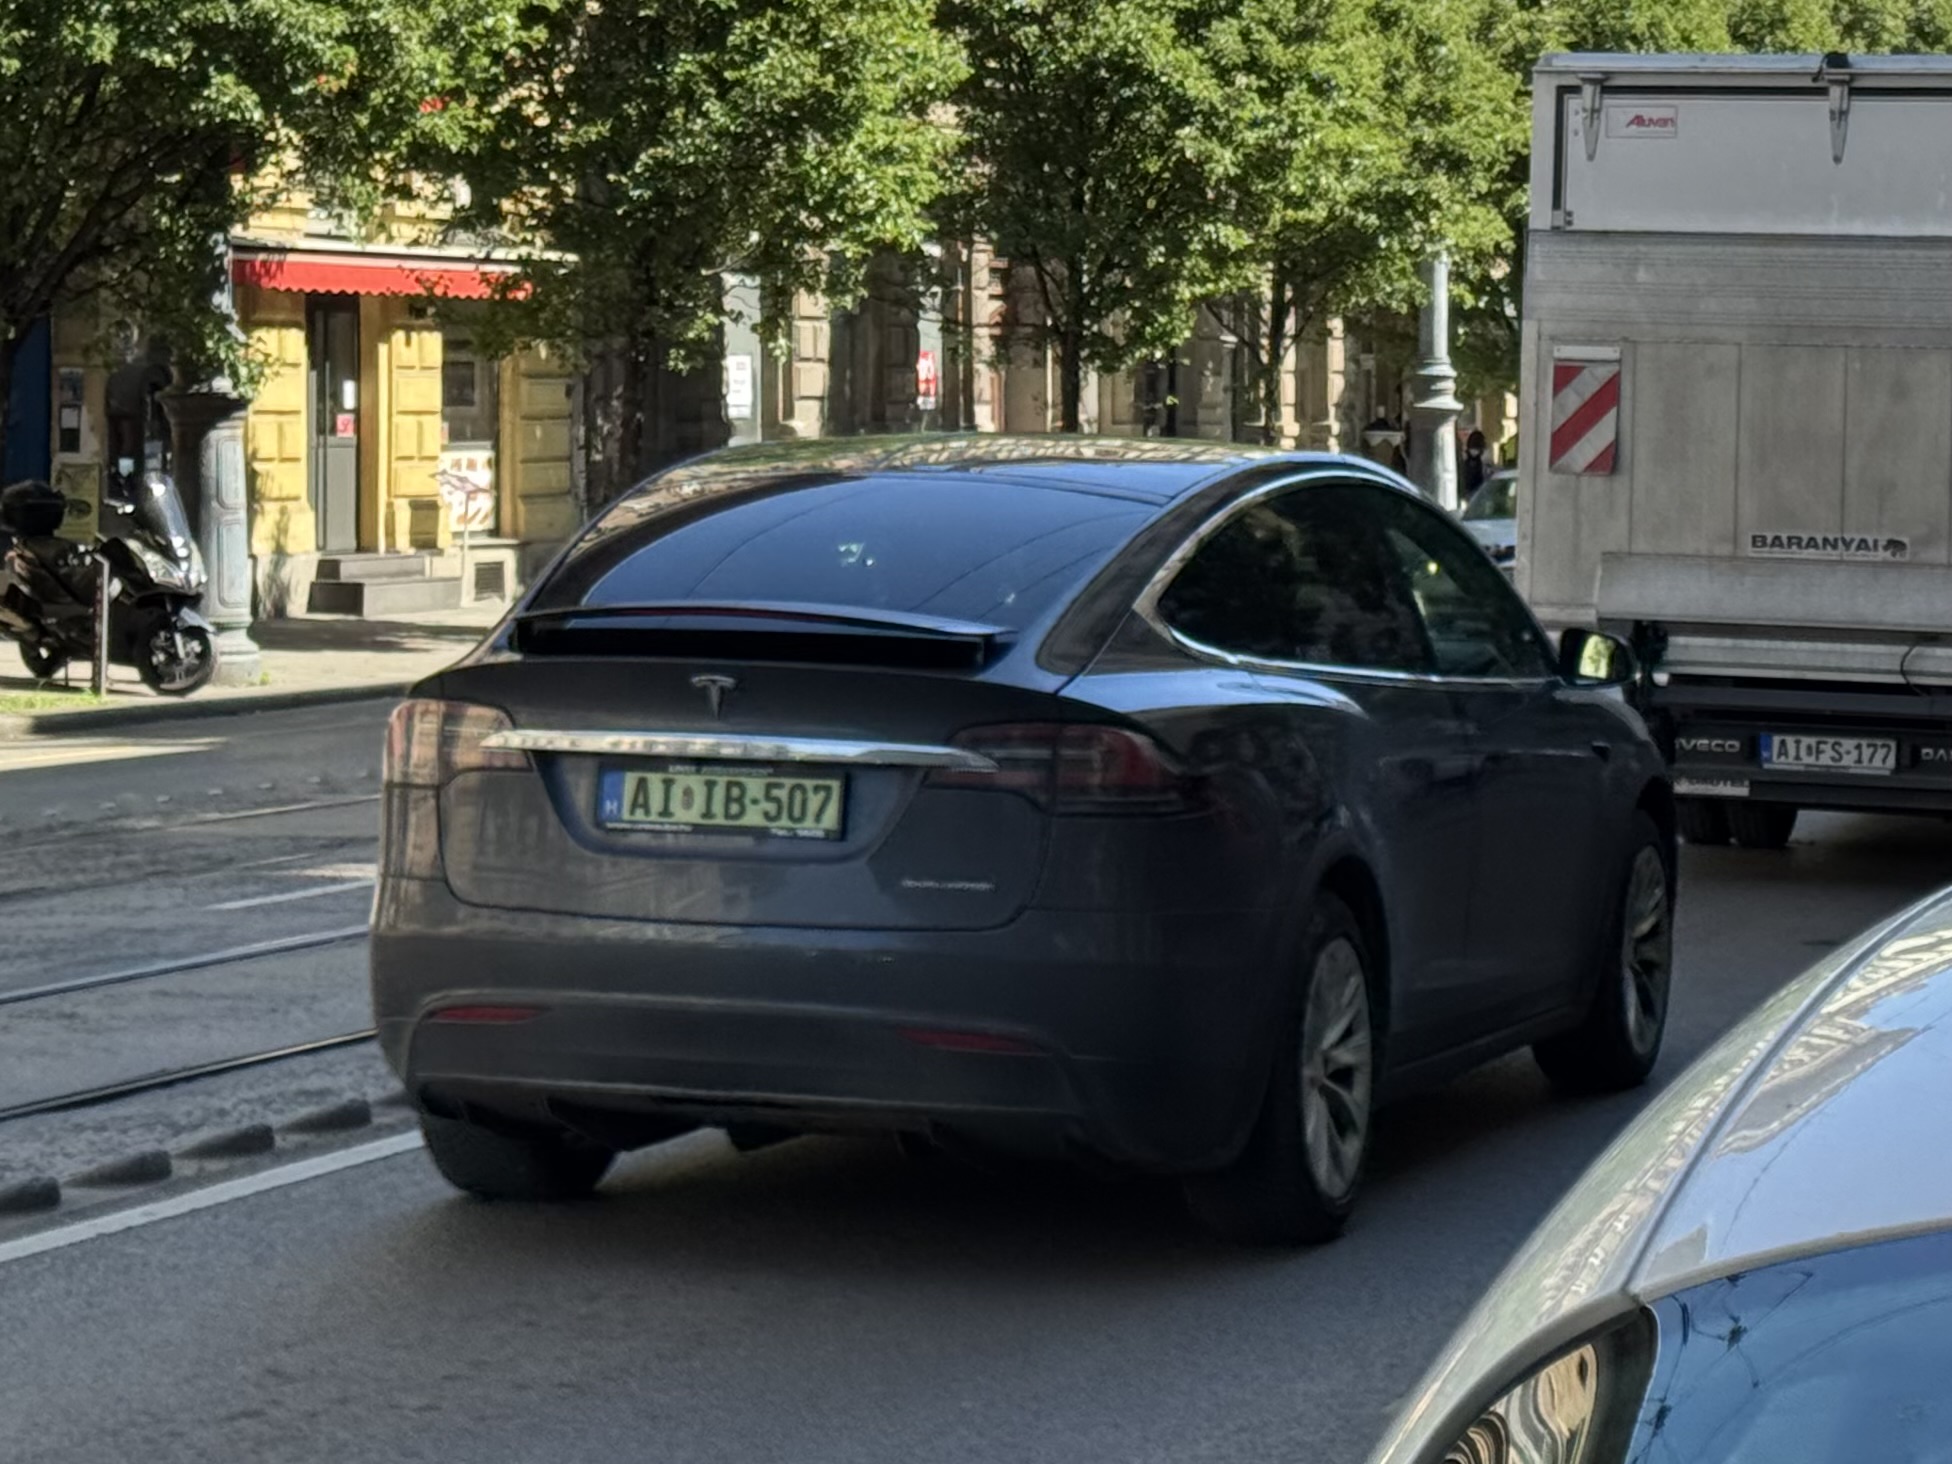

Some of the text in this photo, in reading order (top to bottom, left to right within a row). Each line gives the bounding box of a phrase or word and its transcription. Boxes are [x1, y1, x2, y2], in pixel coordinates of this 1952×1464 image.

[1751, 534, 1878, 553] BARANYAI
[1674, 738, 1740, 752] IVECO
[700, 779, 833, 824] IB-507
